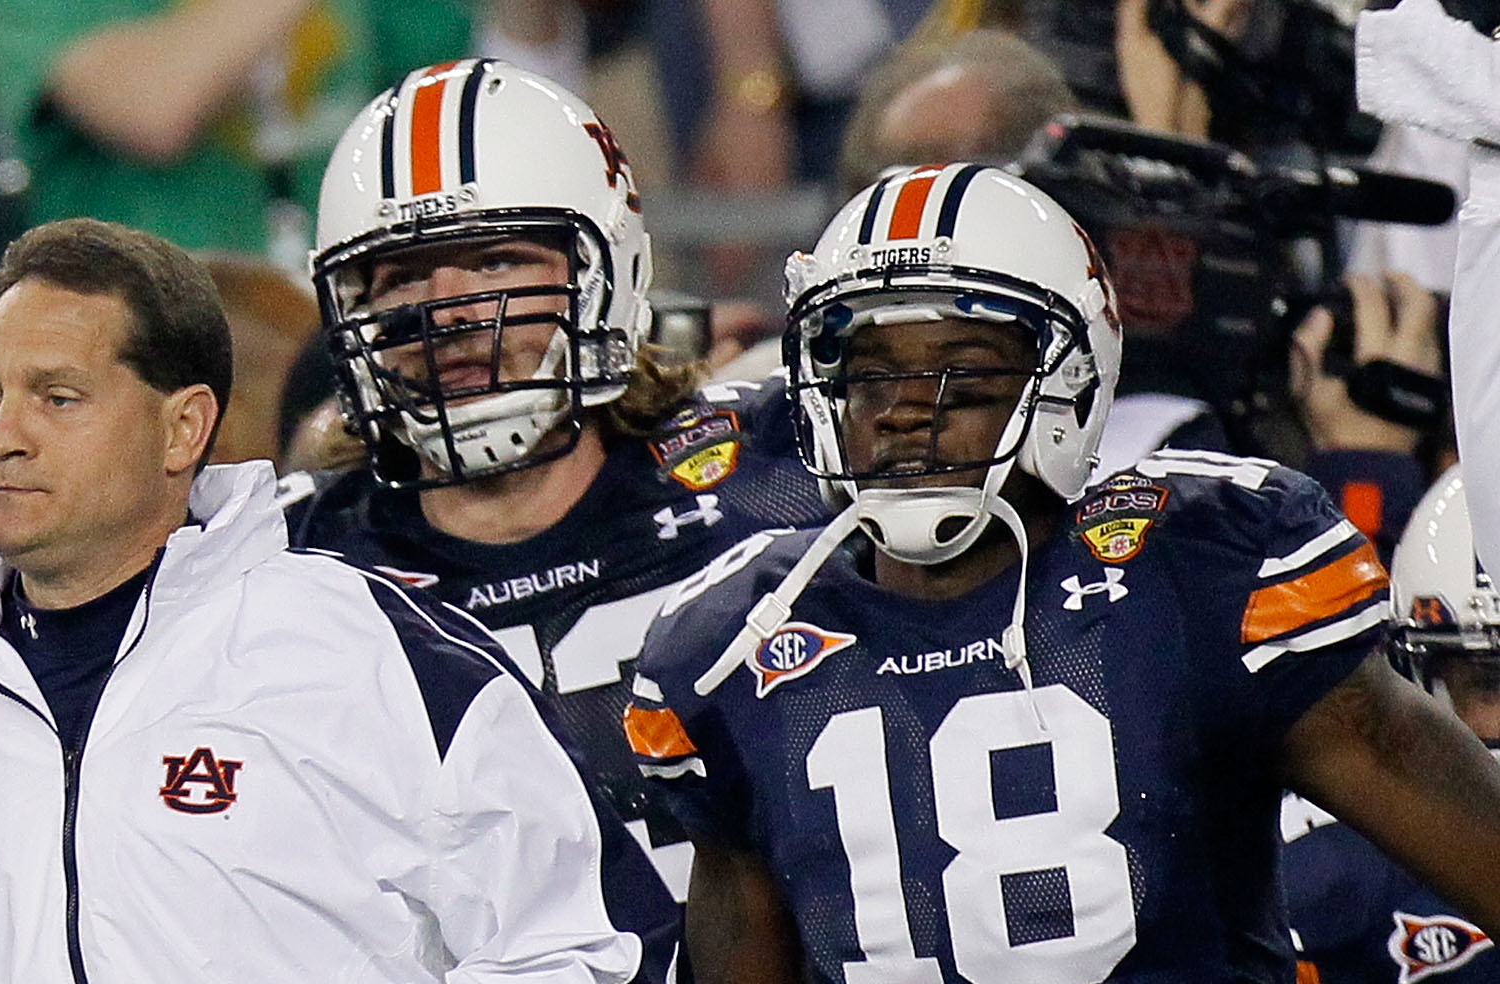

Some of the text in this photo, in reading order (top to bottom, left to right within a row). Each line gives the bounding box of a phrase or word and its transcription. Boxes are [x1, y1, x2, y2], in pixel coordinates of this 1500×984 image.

[872, 248, 931, 266] TIGERS
[1082, 493, 1158, 520] BCS
[467, 559, 601, 609] AUBURN
[768, 632, 807, 671] SEC
[159, 746, 244, 815] AU
[1414, 925, 1457, 963] SEC
